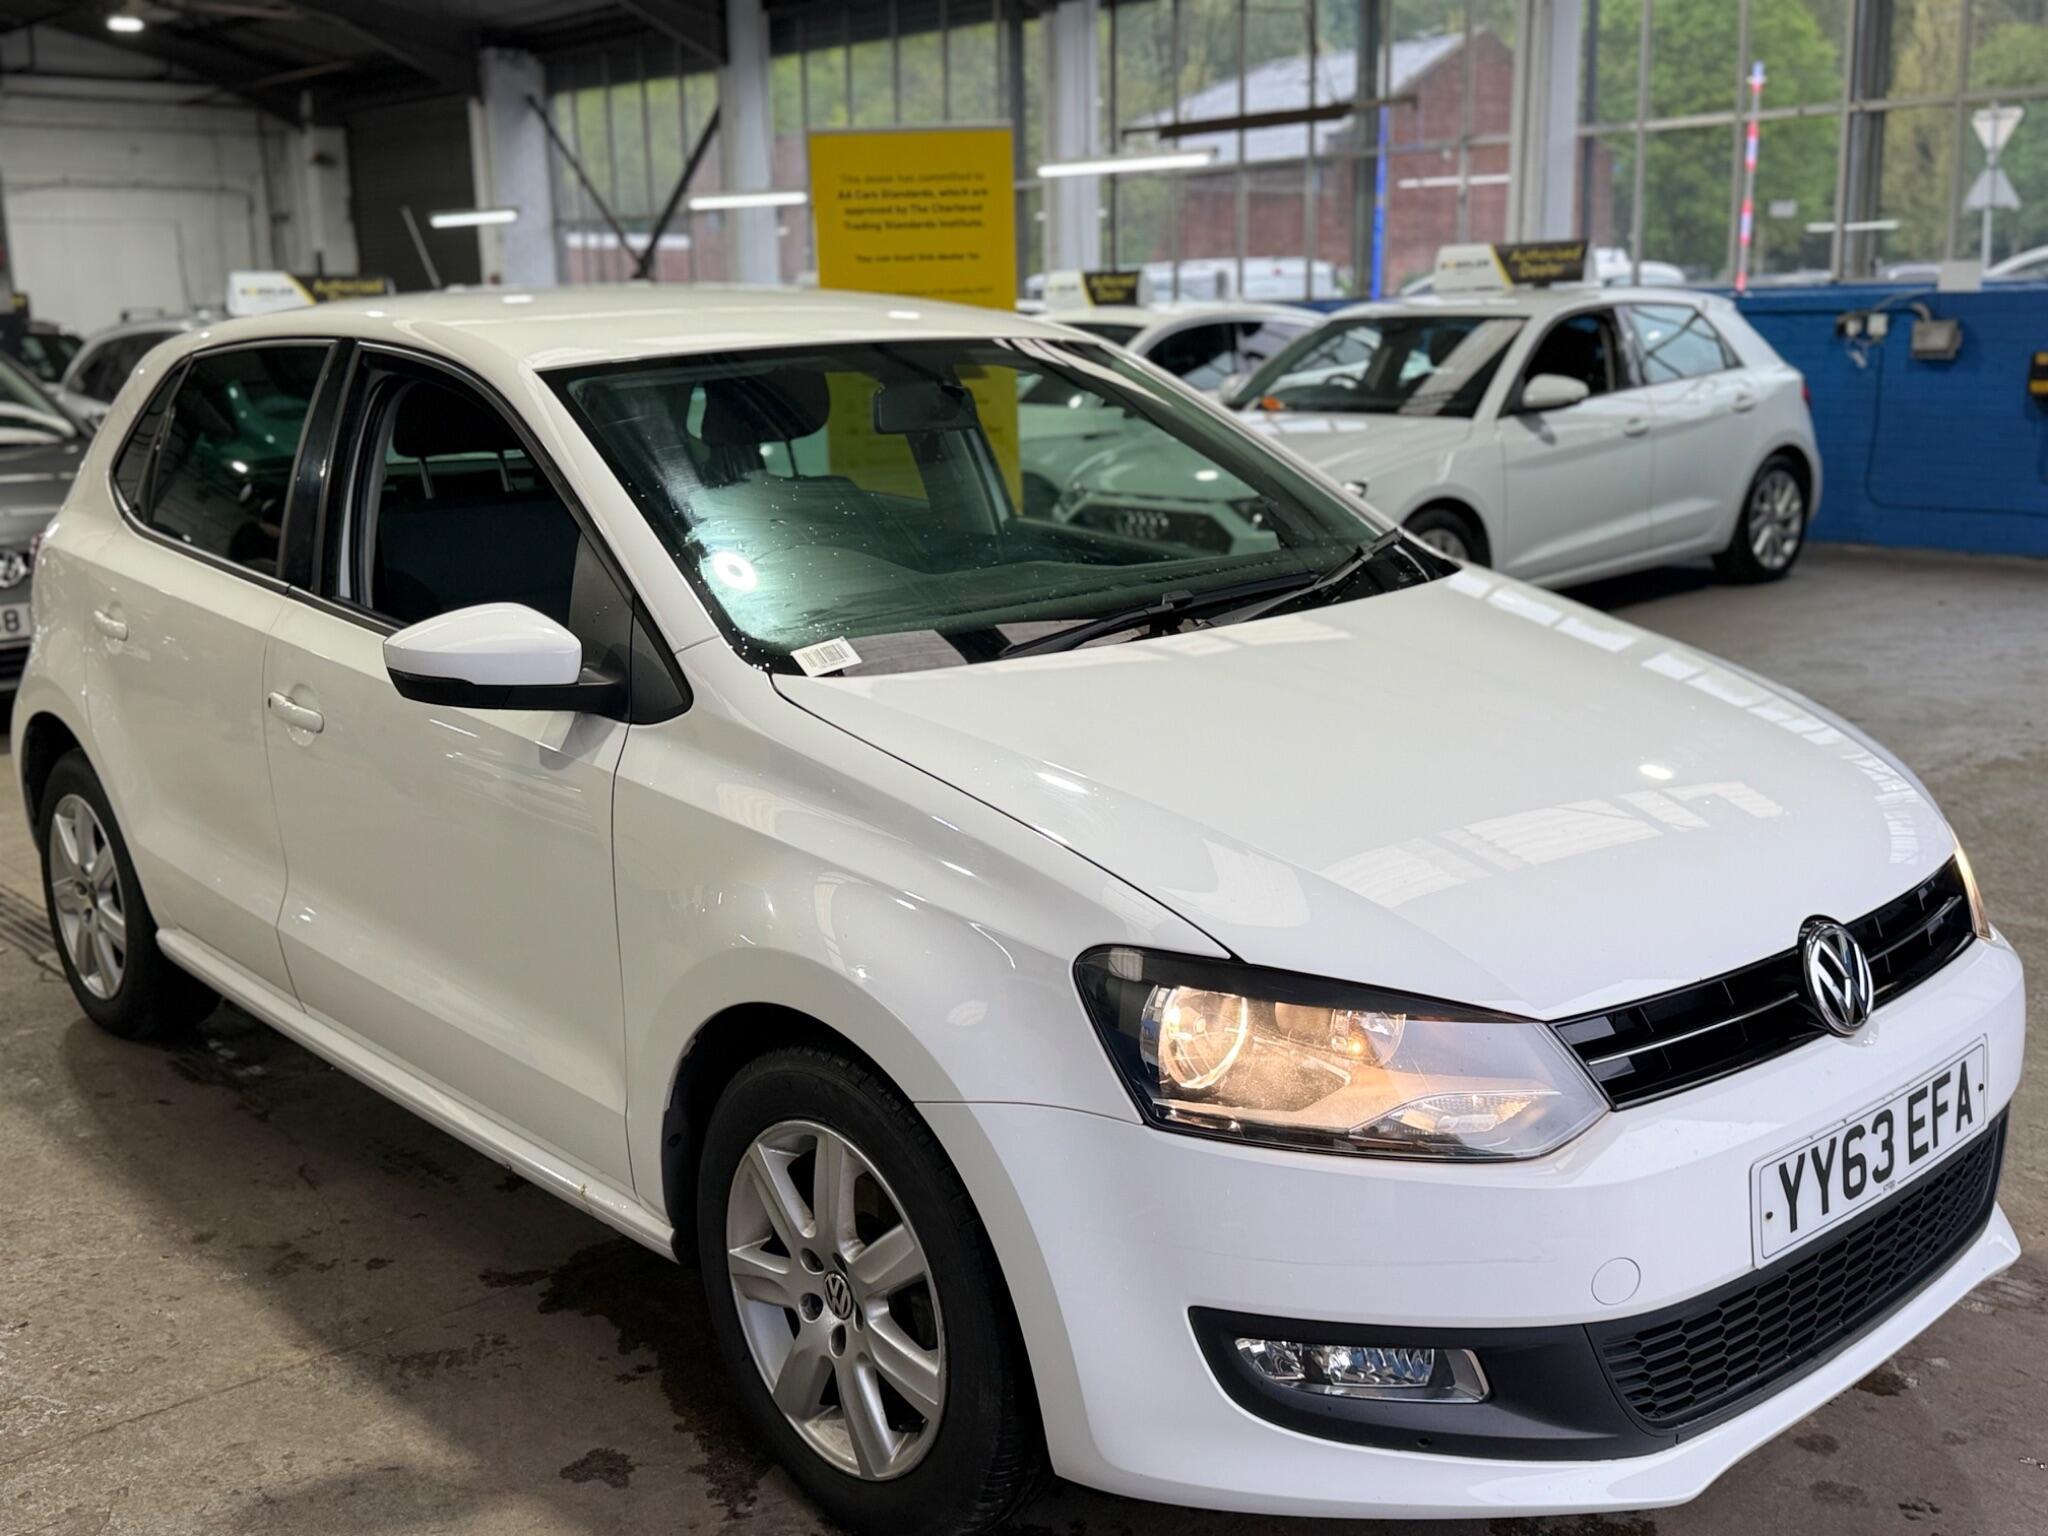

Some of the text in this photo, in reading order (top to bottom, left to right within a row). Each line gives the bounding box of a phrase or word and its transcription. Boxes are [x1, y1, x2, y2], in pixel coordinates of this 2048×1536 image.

[864, 173, 893, 183] dealer
[918, 171, 970, 182] committed
[854, 190, 878, 199] Cars
[939, 187, 969, 196] which
[972, 188, 988, 197] are
[844, 202, 983, 217] approved by The Chartered
[844, 220, 882, 232] Trading
[885, 219, 936, 230] Standards
[1778, 1060, 1974, 1233] YY63 EFA
